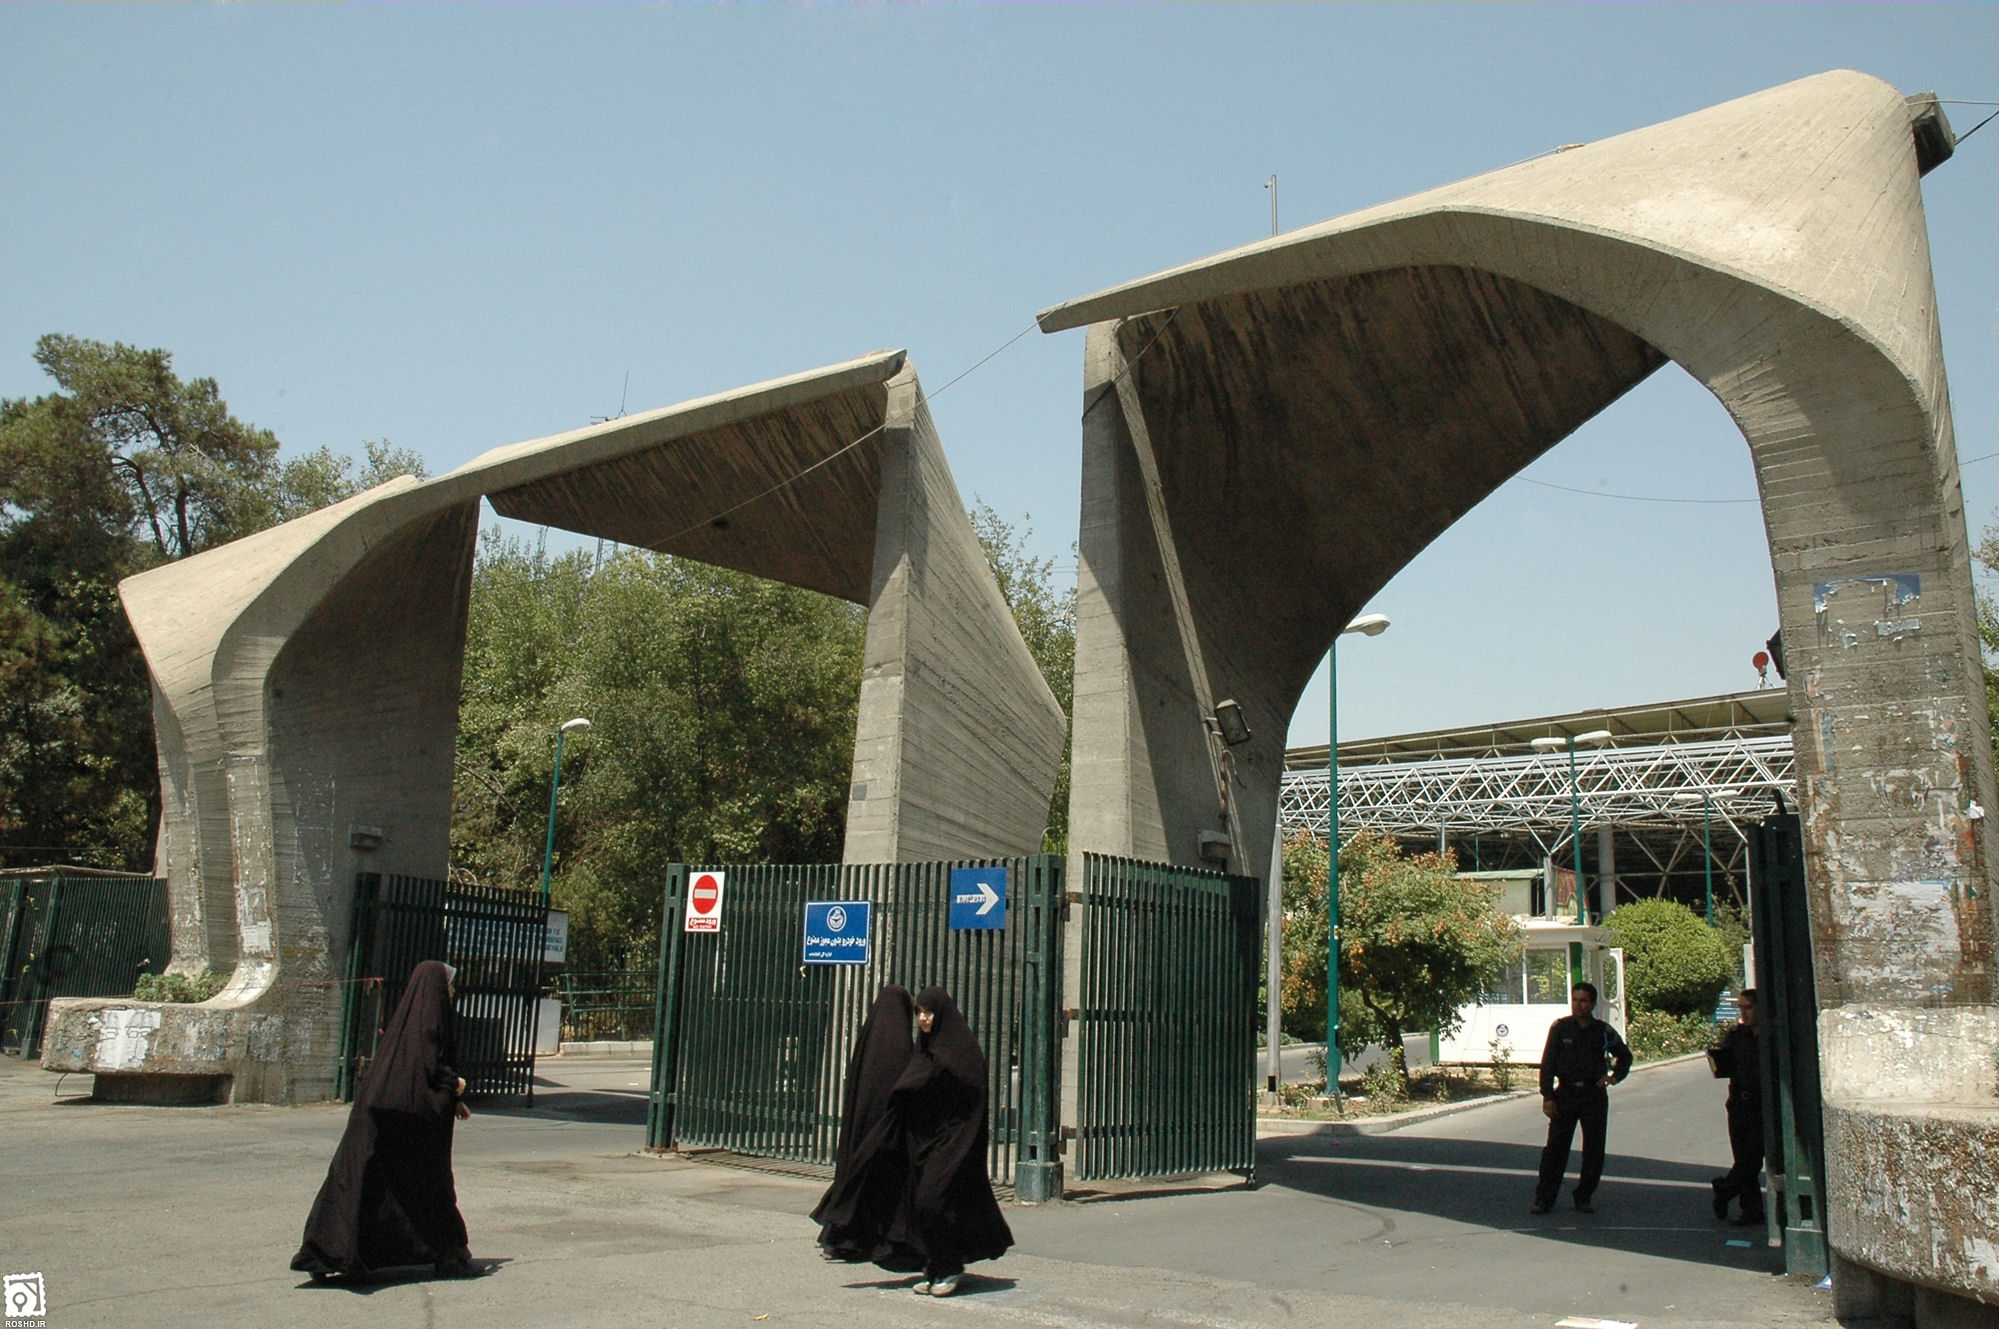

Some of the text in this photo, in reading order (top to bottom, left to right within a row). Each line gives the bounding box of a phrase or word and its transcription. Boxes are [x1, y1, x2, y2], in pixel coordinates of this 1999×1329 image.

[806, 936, 819, 946] ممنوع
[830, 936, 841, 946] بدون
[842, 936, 855, 946] خودرو
[856, 937, 866, 946] ورود
